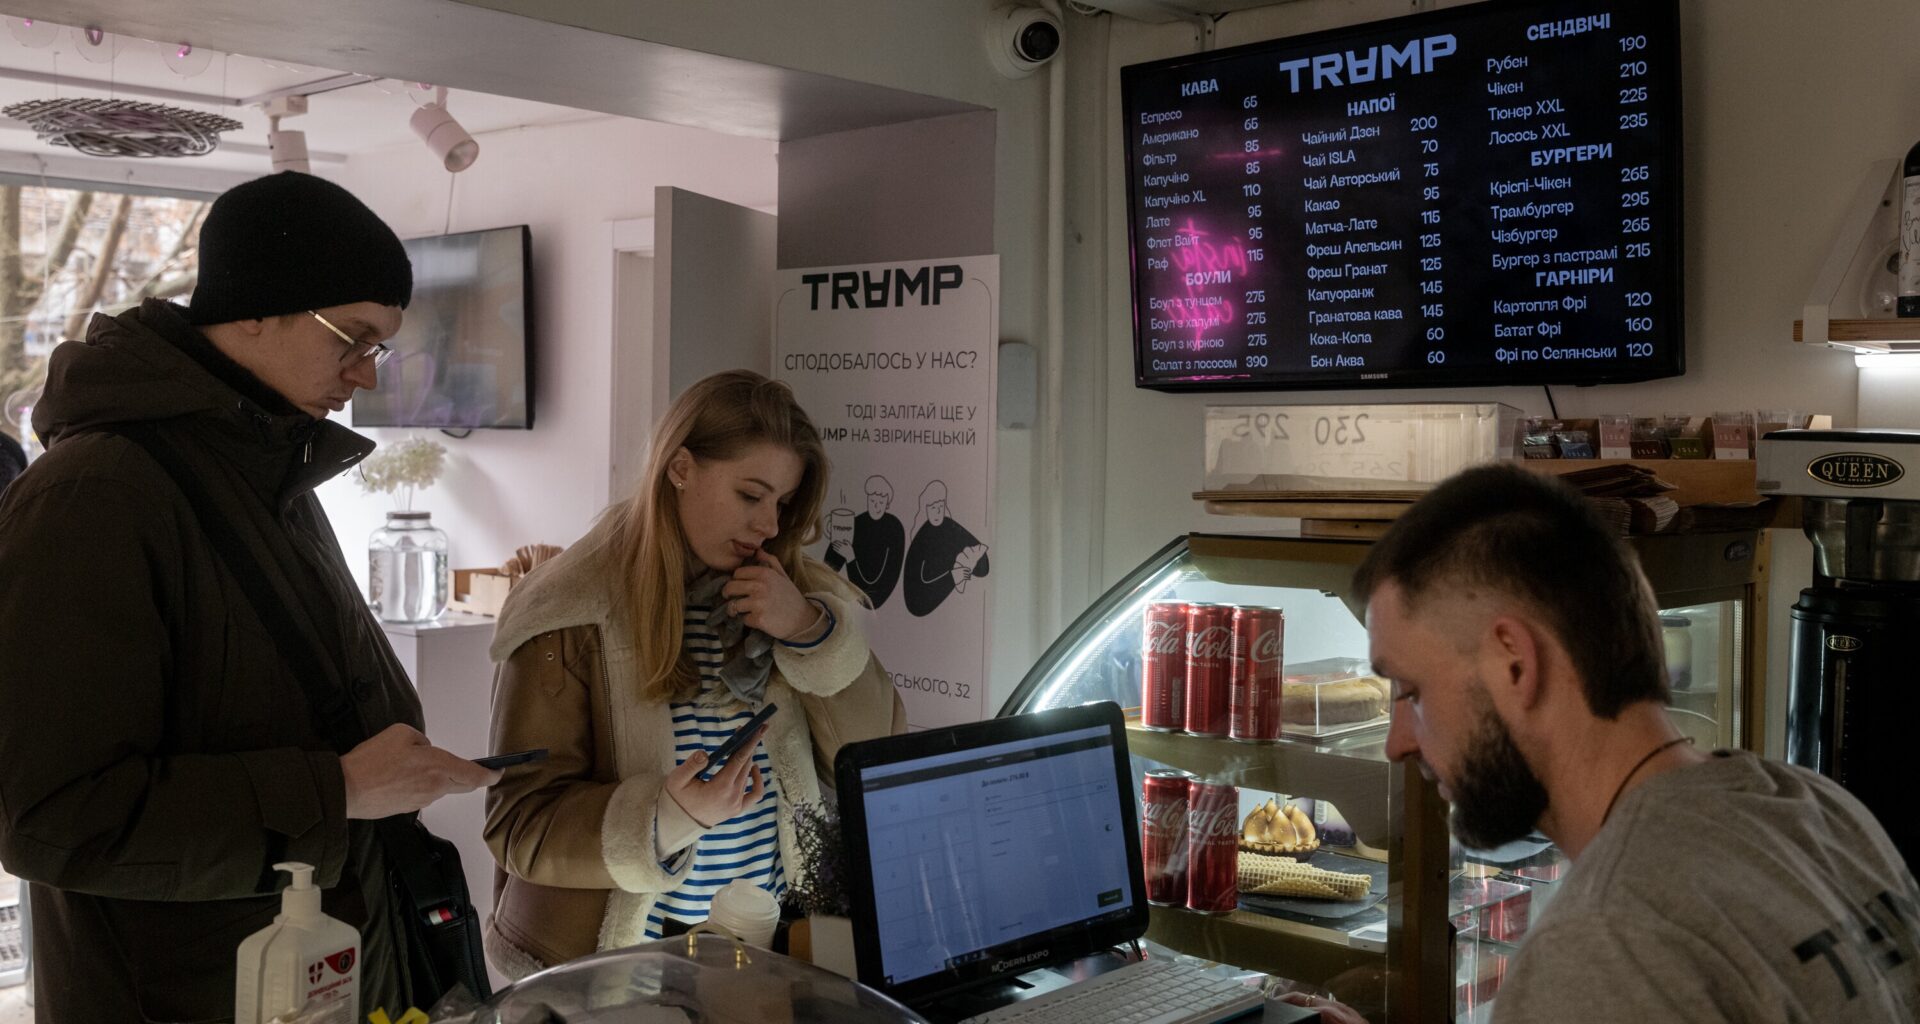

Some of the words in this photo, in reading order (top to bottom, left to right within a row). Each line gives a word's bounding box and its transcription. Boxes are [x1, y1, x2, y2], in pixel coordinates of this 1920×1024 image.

[1526, 13, 1610, 41] СЕНДВІЧІ
[1487, 56, 1528, 73] Рубен
[1619, 35, 1646, 52] 190
[1181, 79, 1219, 96] КАВА
[1488, 81, 1523, 96] Чікен
[1620, 61, 1647, 78] 210
[1141, 109, 1182, 125] Еспресо
[1243, 96, 1258, 108] 65
[1347, 93, 1395, 117] НАПОЇ
[1488, 104, 1532, 121] Тюнер
[1536, 99, 1564, 115] XXL
[1620, 87, 1647, 104] 225
[1142, 128, 1199, 146] Американо
[1244, 118, 1258, 130] 65
[1302, 129, 1346, 146] Чайний
[1350, 125, 1380, 140] Дзен
[1410, 116, 1438, 131] 200
[1489, 131, 1537, 145] Лосось
[1541, 123, 1570, 139] XXL
[1620, 113, 1648, 129] 235
[1143, 153, 1177, 169] Фільтр
[1245, 140, 1259, 152] 85
[1303, 152, 1325, 168] Чай
[1329, 150, 1355, 164] ISLA
[1422, 139, 1438, 154] 70
[1531, 142, 1612, 166] БУРГЕРИ
[1144, 172, 1189, 189] Капучіно
[1246, 162, 1260, 174] 85
[1304, 175, 1327, 190] Чай
[1330, 168, 1400, 189] Авторський
[1424, 163, 1439, 177] 75
[1490, 176, 1571, 198] Кріспі-Чікен
[1621, 166, 1648, 182] 265
[1144, 194, 1190, 209] Капучіно
[1193, 190, 1206, 202] XL
[1243, 184, 1261, 196] 110
[1305, 199, 1340, 213] Какао
[1424, 187, 1439, 200] 95
[1491, 200, 1574, 220] Трамбургер
[1622, 191, 1649, 208] 295
[1146, 217, 1170, 228] Лате
[1248, 206, 1262, 217] 95
[1306, 219, 1378, 235] Матча-Лате
[1421, 211, 1440, 224] 115
[1147, 237, 1172, 249] Флет
[1175, 234, 1200, 246] Вайт
[1249, 228, 1262, 240] 95
[1492, 228, 1558, 244] Чізбургер
[1622, 217, 1649, 233] 265
[1306, 244, 1341, 260] Фреш
[1344, 238, 1402, 254] Апельсин
[1420, 234, 1441, 247] 125
[1492, 252, 1539, 268] Бургер
[1543, 254, 1550, 263] з
[1554, 246, 1618, 266] пастрамі
[1626, 243, 1650, 258] 215
[1148, 257, 1169, 270] Раф
[1247, 249, 1264, 262] 115
[1308, 266, 1342, 281] Фреш
[1346, 262, 1388, 278] Гранат
[1420, 257, 1442, 271] 125
[1186, 270, 1232, 286] БОУЛИ
[1536, 267, 1614, 287] ГАРНІРИ
[1150, 298, 1173, 310] Боул
[1246, 291, 1265, 303] 275
[1308, 286, 1374, 302] Капуоранж
[1420, 281, 1442, 294] 145
[1309, 310, 1372, 326] Гранатова
[1374, 308, 1403, 320] кава
[1421, 304, 1443, 318] 145
[1494, 298, 1558, 315] Картопля
[1562, 296, 1586, 313] Фрі
[1625, 292, 1652, 307] 120
[1151, 318, 1174, 331] Боул
[1247, 312, 1266, 324] 275
[1494, 322, 1534, 338] Батат
[1537, 321, 1561, 338] Фрі
[1625, 317, 1653, 332] 160
[1152, 339, 1176, 352] Боул
[1187, 338, 1224, 351] куркою
[1248, 334, 1267, 346] 275
[1310, 332, 1372, 346] Кока-Кола
[1426, 328, 1444, 340] 60
[784, 351, 912, 373] СПОДОБАЛОСЬ
[916, 352, 927, 370] У
[931, 350, 978, 370] НАС?
[1153, 358, 1183, 371] Салат
[1193, 358, 1237, 370] лососем
[1246, 356, 1268, 368] 390
[1311, 355, 1333, 368] Бон
[1336, 355, 1365, 368] Аква
[1427, 351, 1445, 364] 60
[1495, 347, 1518, 364] Фрі
[1521, 350, 1538, 361] по
[1542, 346, 1616, 360] Селянськи
[1626, 343, 1653, 357] 120
[846, 404, 876, 420] ТОДІ
[880, 402, 936, 421] ЗАЛІТАЙ
[940, 406, 964, 422] ЩЕ
[967, 406, 977, 421] У
[852, 428, 871, 442] НА
[874, 428, 976, 447] ЗВІРИНЕЦЬКІЙ
[1718, 433, 1742, 441] ISLA
[1822, 462, 1890, 479] QUEEN
[956, 682, 970, 699] 32
[1027, 949, 1049, 962] EXPO
